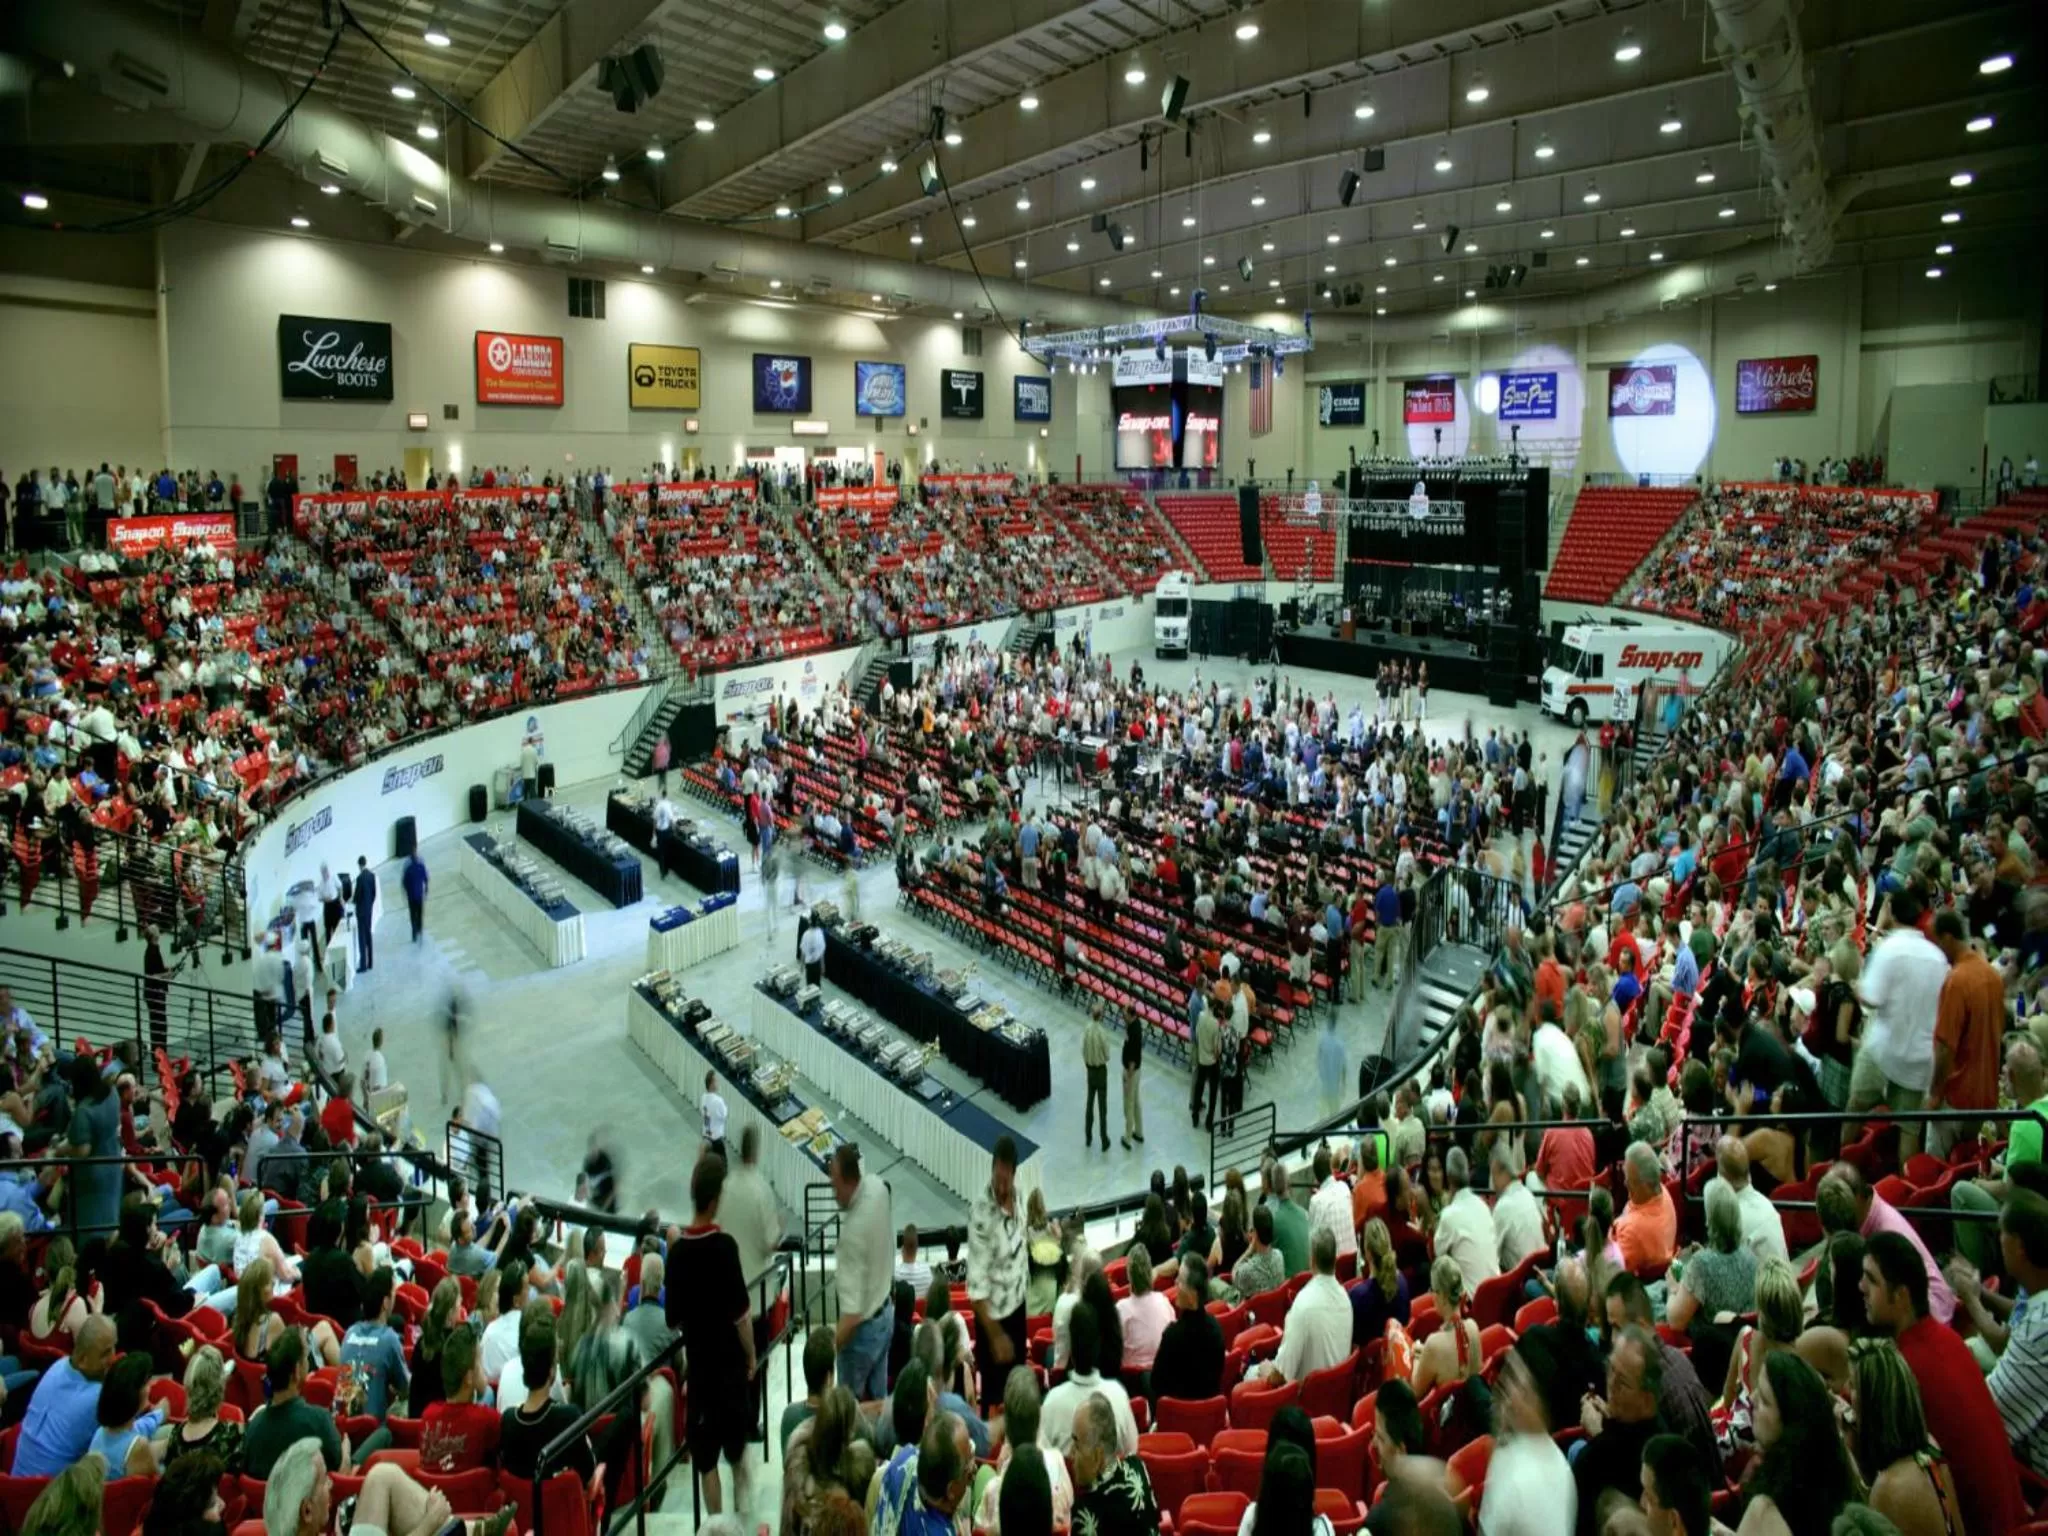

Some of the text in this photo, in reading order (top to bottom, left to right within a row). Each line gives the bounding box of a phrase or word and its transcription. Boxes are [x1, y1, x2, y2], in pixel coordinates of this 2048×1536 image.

[288, 330, 387, 379] Lucchese
[658, 366, 697, 377] TOYOTA
[772, 360, 798, 372] PEPSI
[337, 372, 378, 387] BOOTS
[658, 378, 697, 390] TRUCKS
[1118, 412, 1171, 434] Snap-on
[115, 521, 231, 544] Snap-on Snap-on
[1617, 644, 1704, 673] Snap-on
[381, 754, 444, 796] Snap-on
[284, 805, 333, 858] Snap-on
